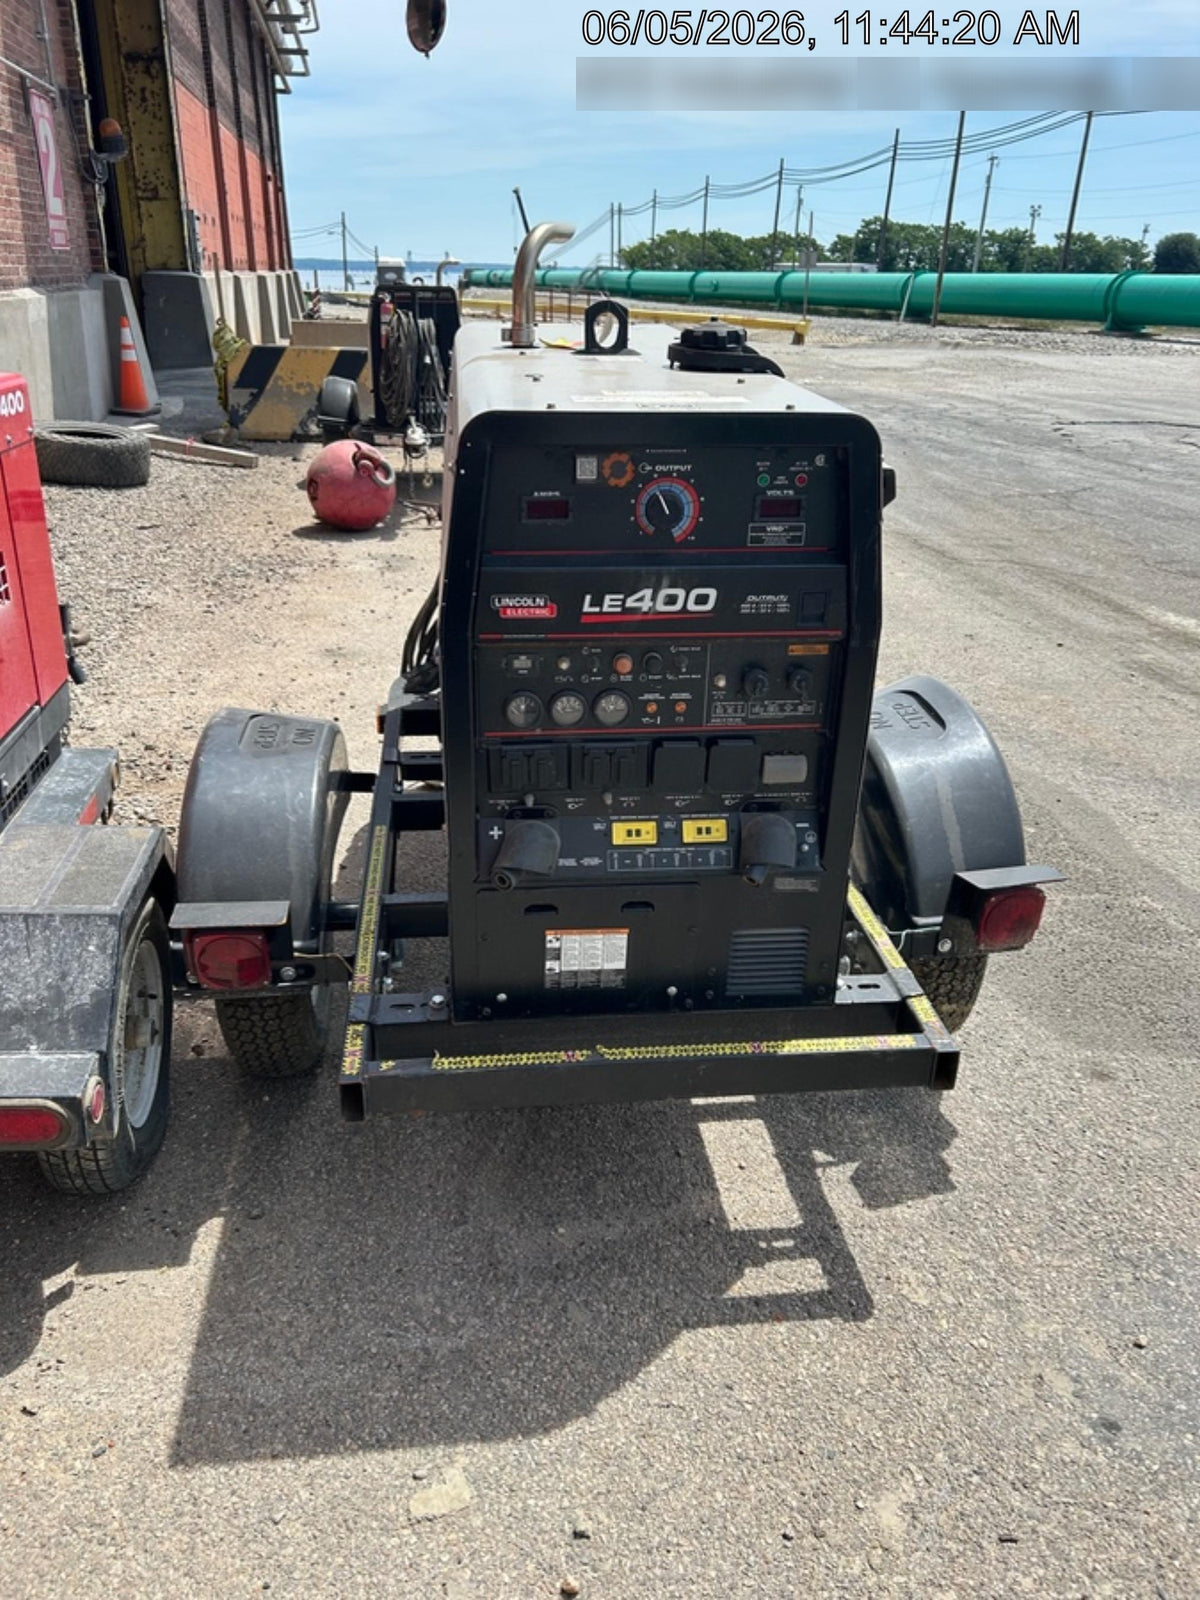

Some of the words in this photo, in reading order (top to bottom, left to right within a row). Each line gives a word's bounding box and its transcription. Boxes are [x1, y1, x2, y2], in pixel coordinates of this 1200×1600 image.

[39, 116, 63, 216] 2
[655, 464, 692, 472] OUTPUT
[494, 597, 545, 607] LINCOLN
[582, 588, 717, 613] LE400
[506, 607, 550, 616] ELECTRIC
[892, 703, 930, 730] STEP
[292, 728, 316, 746] NO
